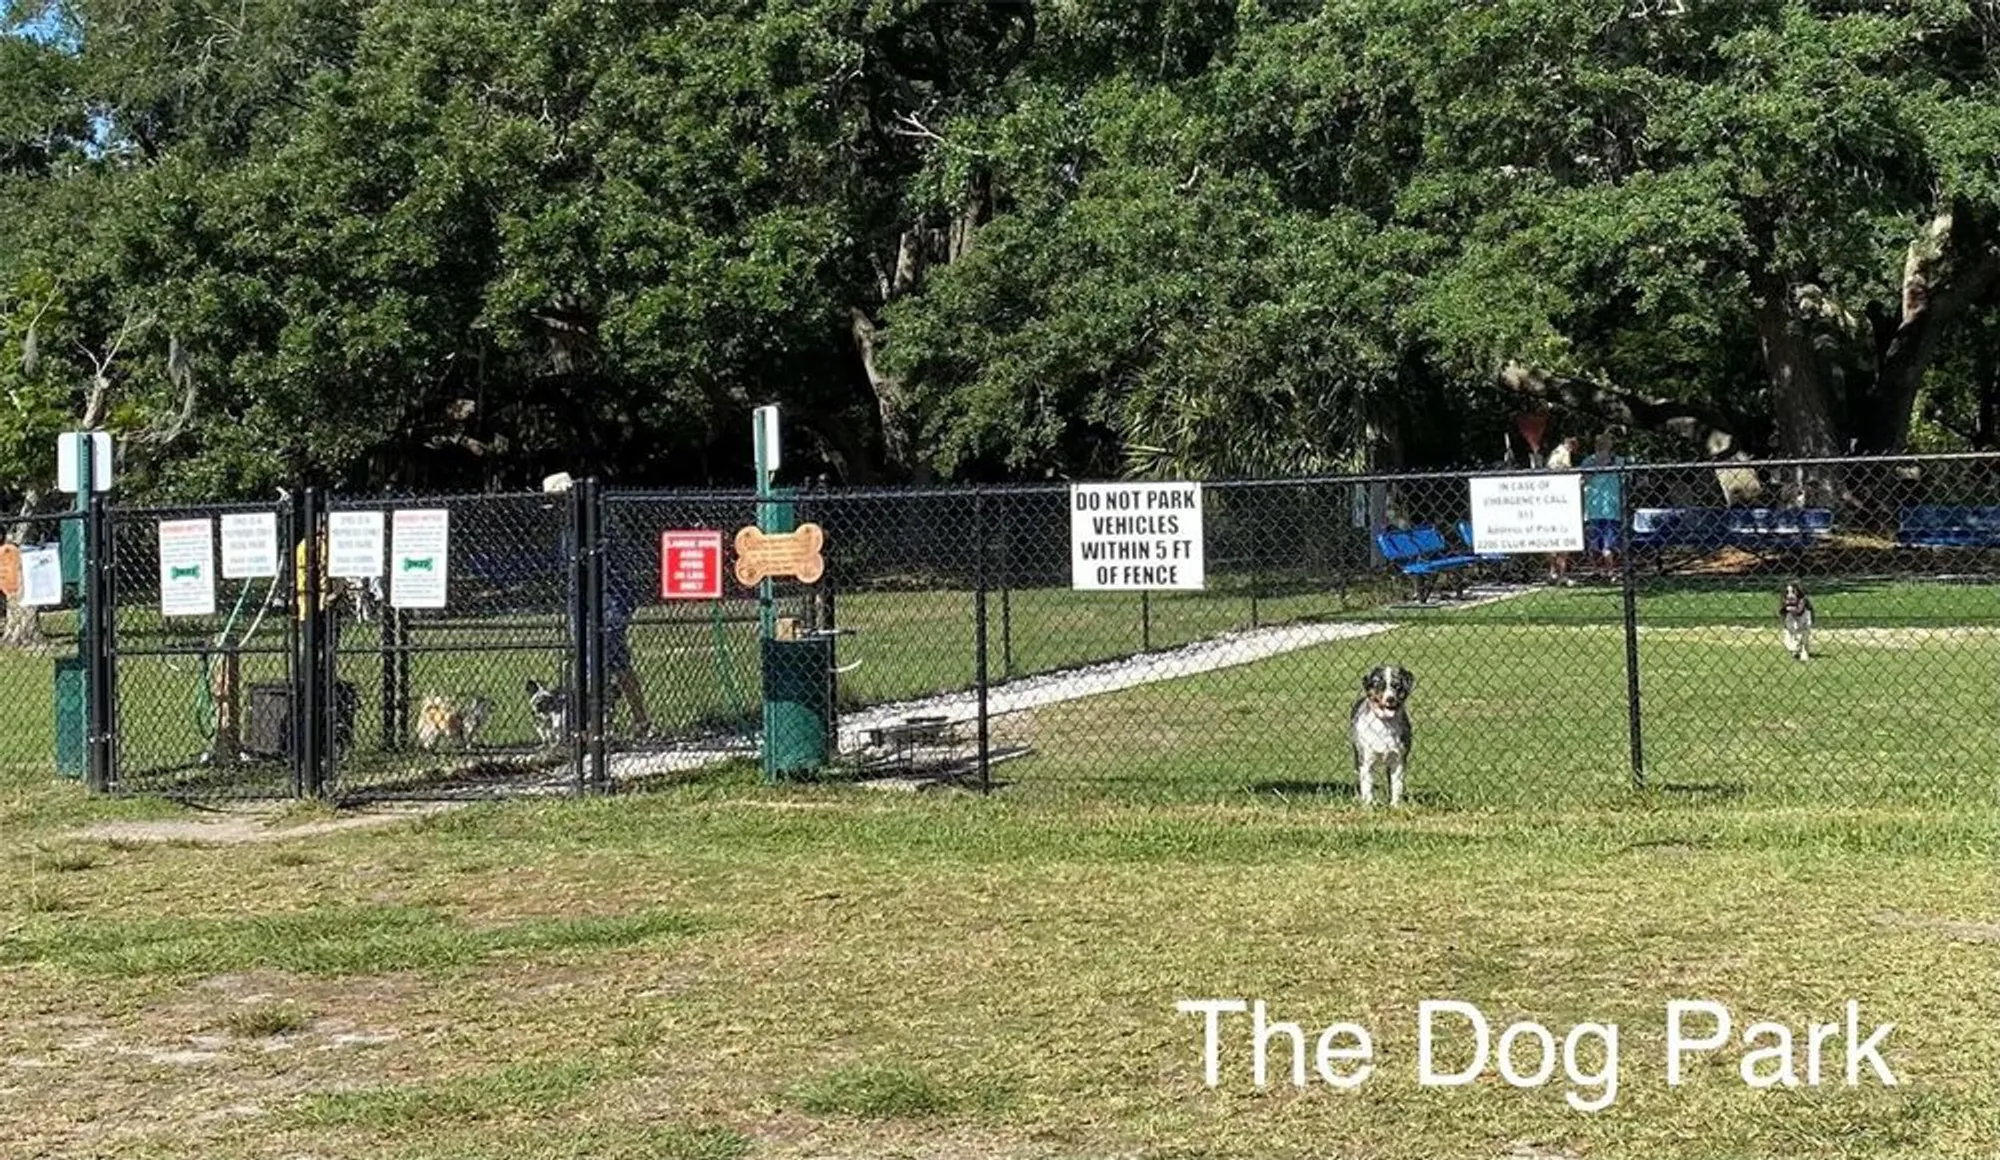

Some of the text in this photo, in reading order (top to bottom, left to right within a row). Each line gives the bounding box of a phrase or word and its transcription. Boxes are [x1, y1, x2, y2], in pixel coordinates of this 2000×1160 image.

[1499, 480, 1550, 492] IN CASE OF
[1076, 489, 1195, 511] DO NOT PARK
[1483, 494, 1568, 507] EMERGENCY CALL
[1092, 514, 1179, 535] VEHICLES
[1081, 540, 1192, 560] WITHIN 5 FT
[1528, 538, 1560, 548] HOUSE
[1097, 565, 1177, 585] OF FENCE
